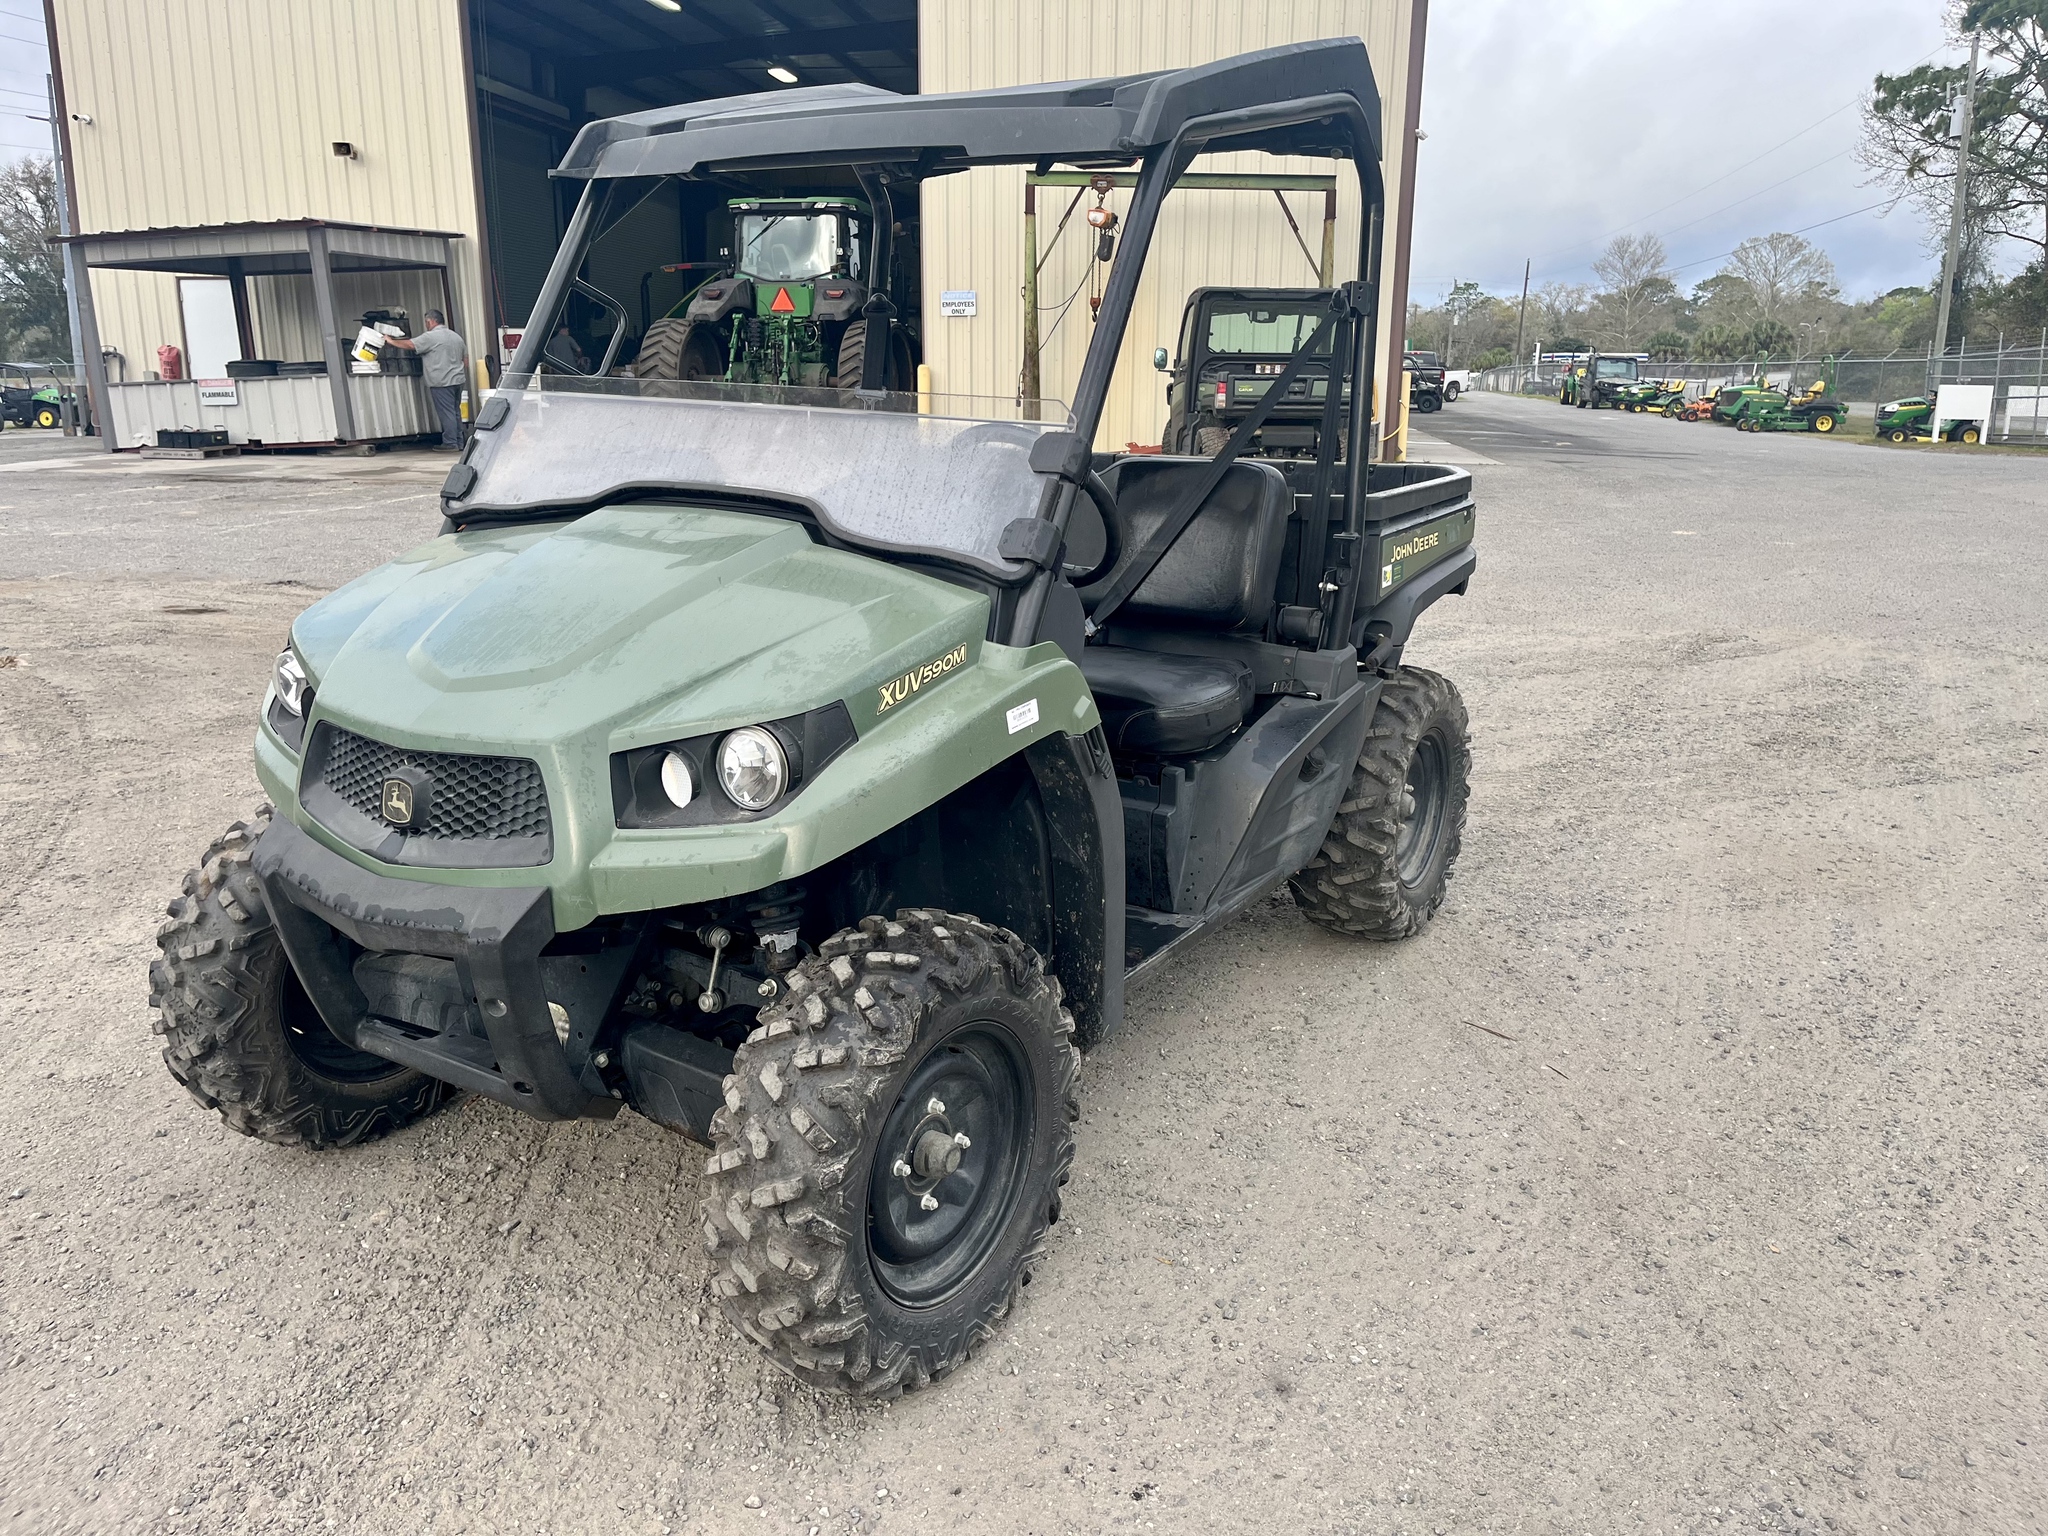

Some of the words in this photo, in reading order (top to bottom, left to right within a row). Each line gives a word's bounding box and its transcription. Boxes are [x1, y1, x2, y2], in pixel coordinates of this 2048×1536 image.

[1390, 541, 1413, 563] JOHN
[1413, 531, 1439, 554] DEERE
[878, 644, 966, 713] XUV590M
